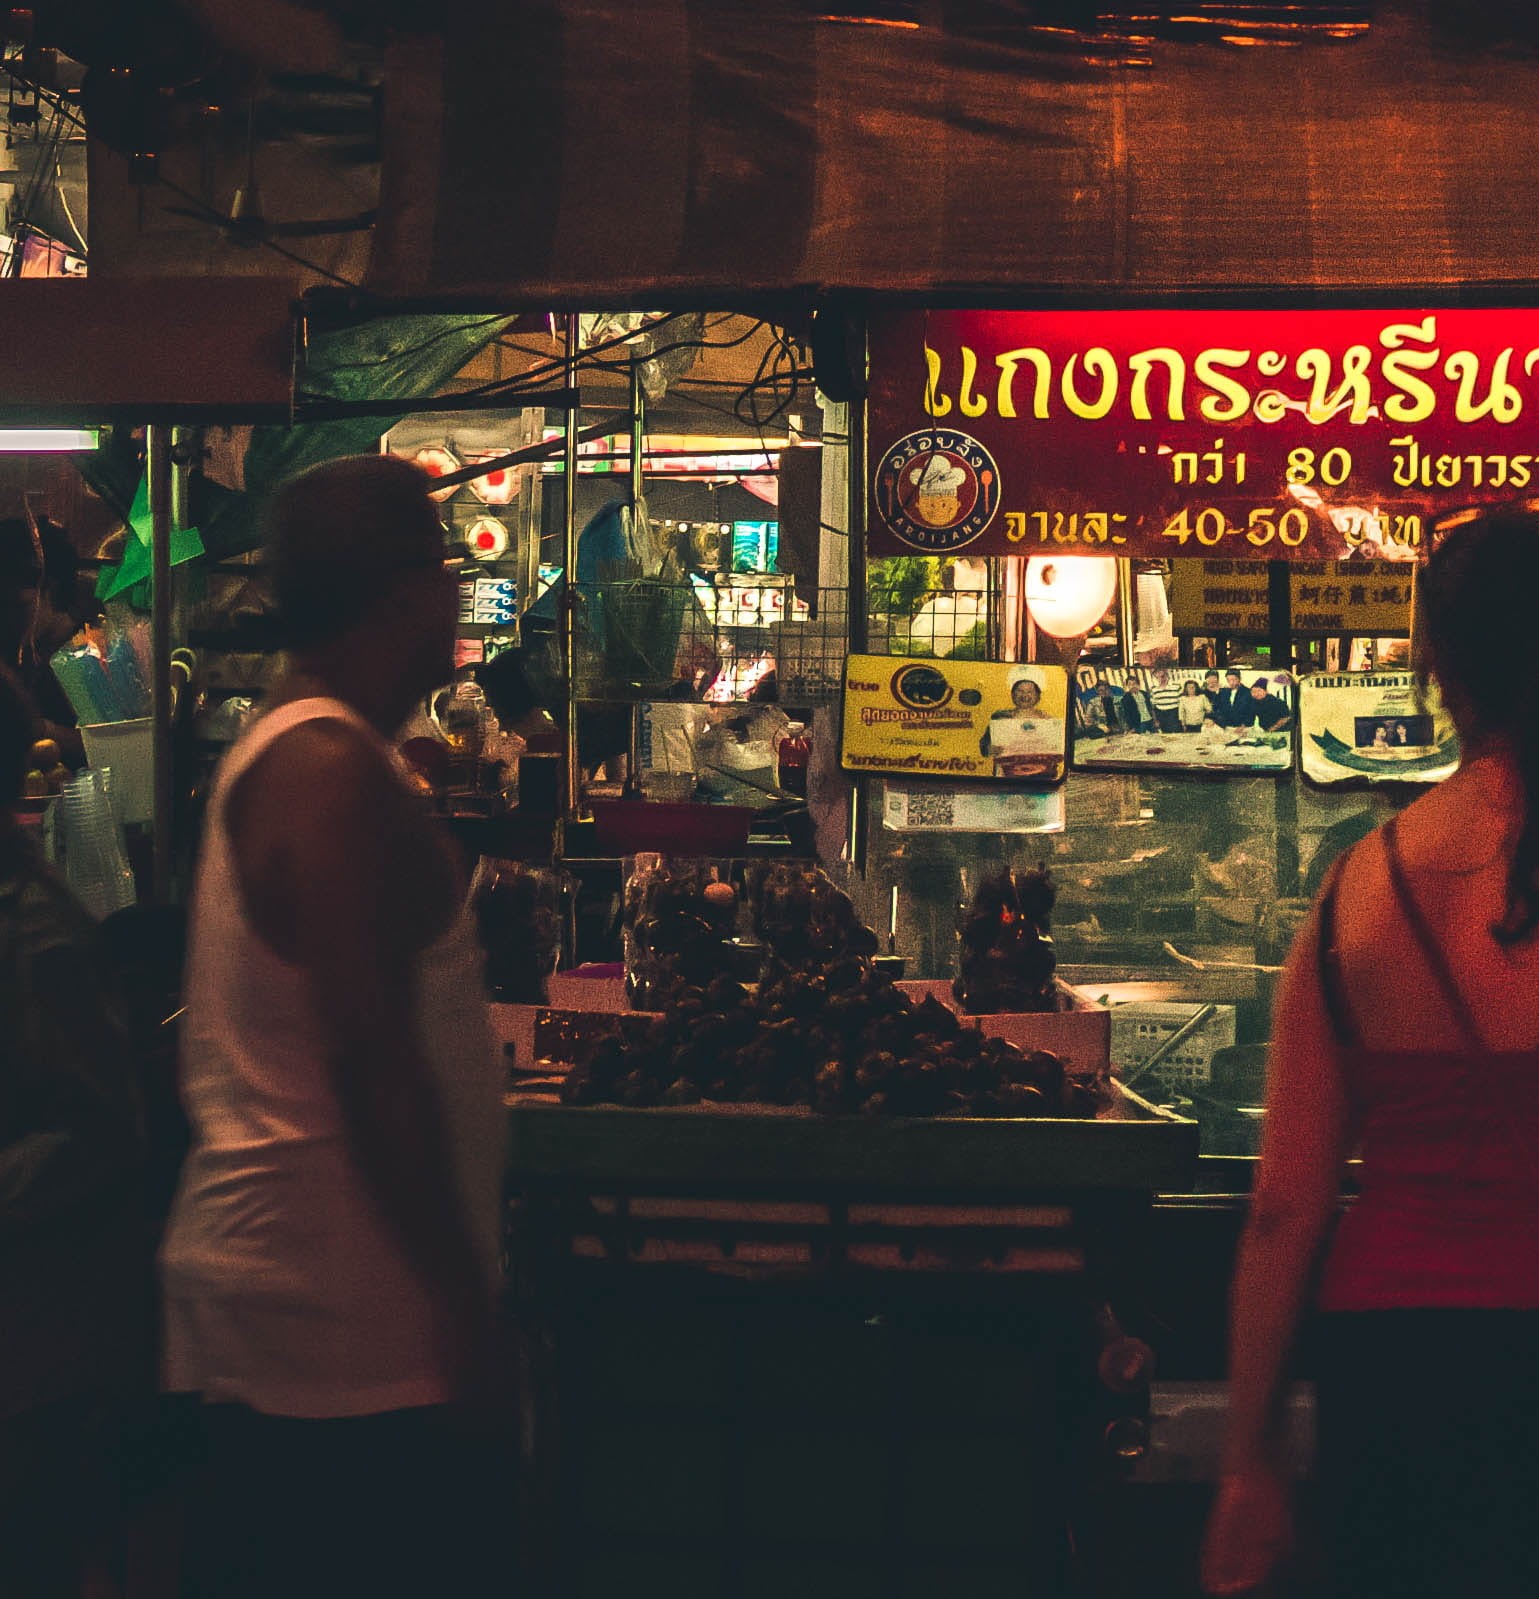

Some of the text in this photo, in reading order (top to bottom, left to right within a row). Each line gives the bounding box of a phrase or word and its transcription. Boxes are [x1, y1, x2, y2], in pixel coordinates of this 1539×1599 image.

[1287, 446, 1352, 487] 80
[1003, 510, 1128, 545] จานละ
[1161, 505, 1309, 547] 40-50
